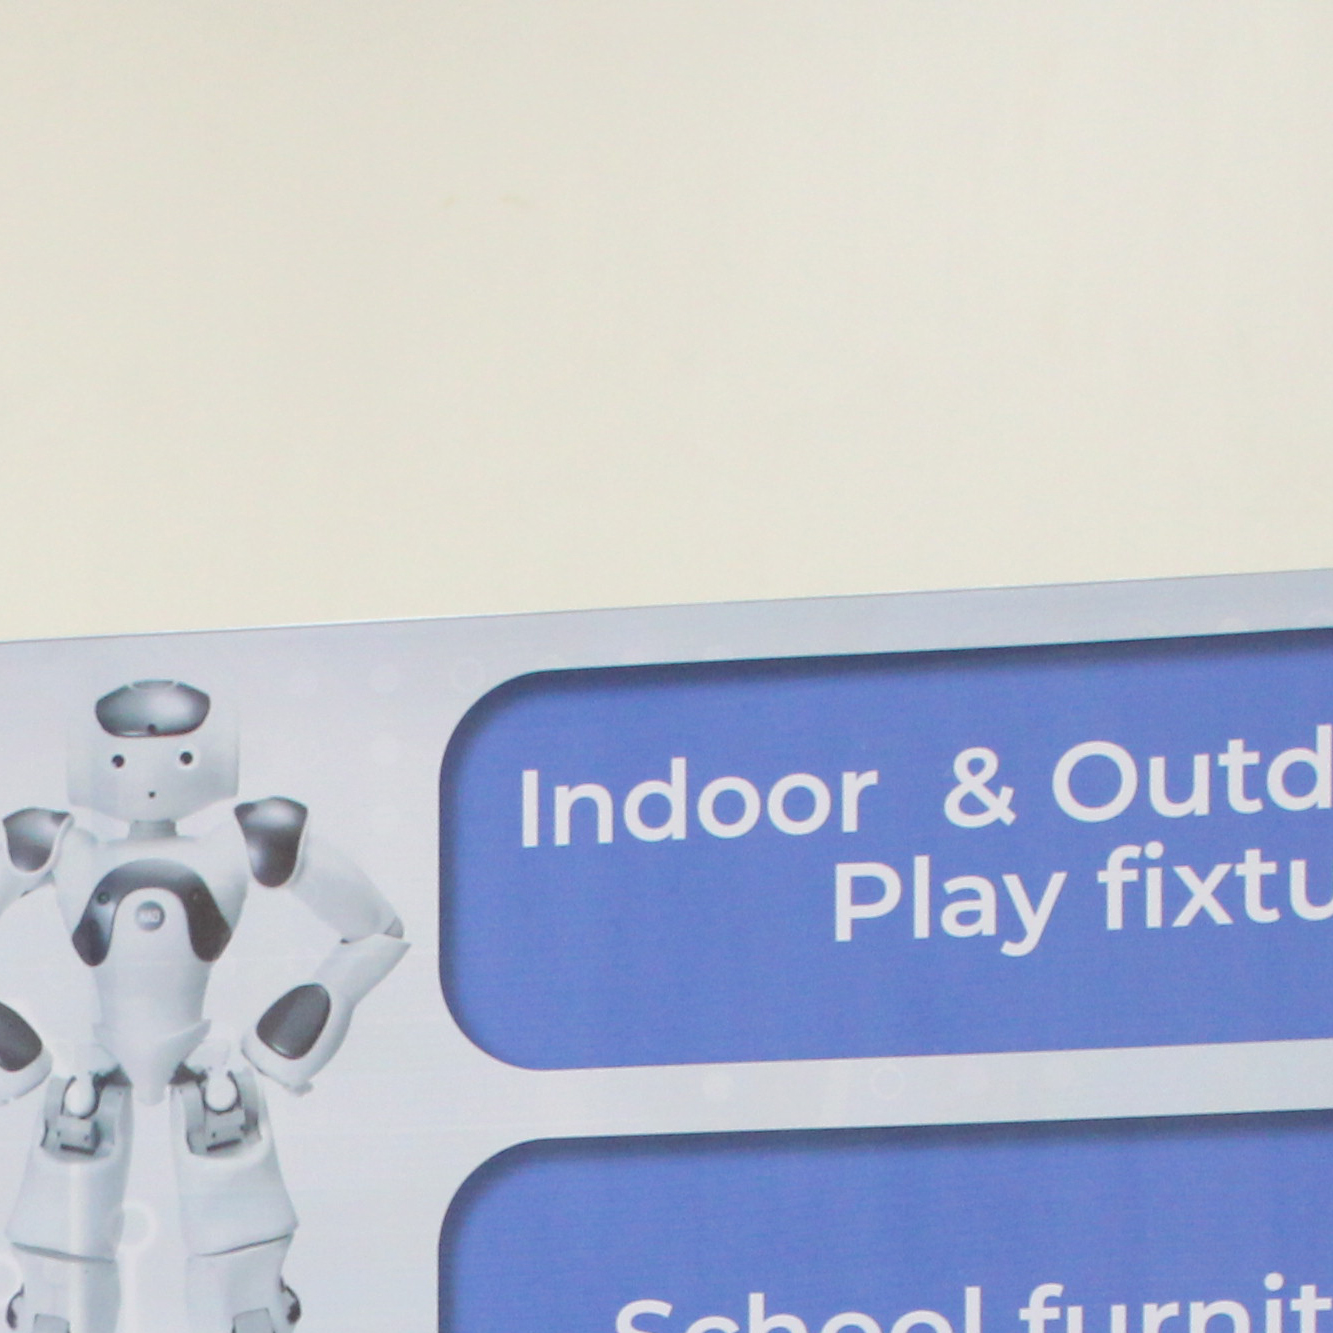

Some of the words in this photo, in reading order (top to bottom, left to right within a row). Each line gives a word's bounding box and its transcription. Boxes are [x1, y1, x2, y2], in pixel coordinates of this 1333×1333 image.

[522, 756, 879, 847] Indoor
[944, 746, 1016, 828] &
[1052, 723, 1333, 822] Outd
[835, 854, 1068, 957] Play
